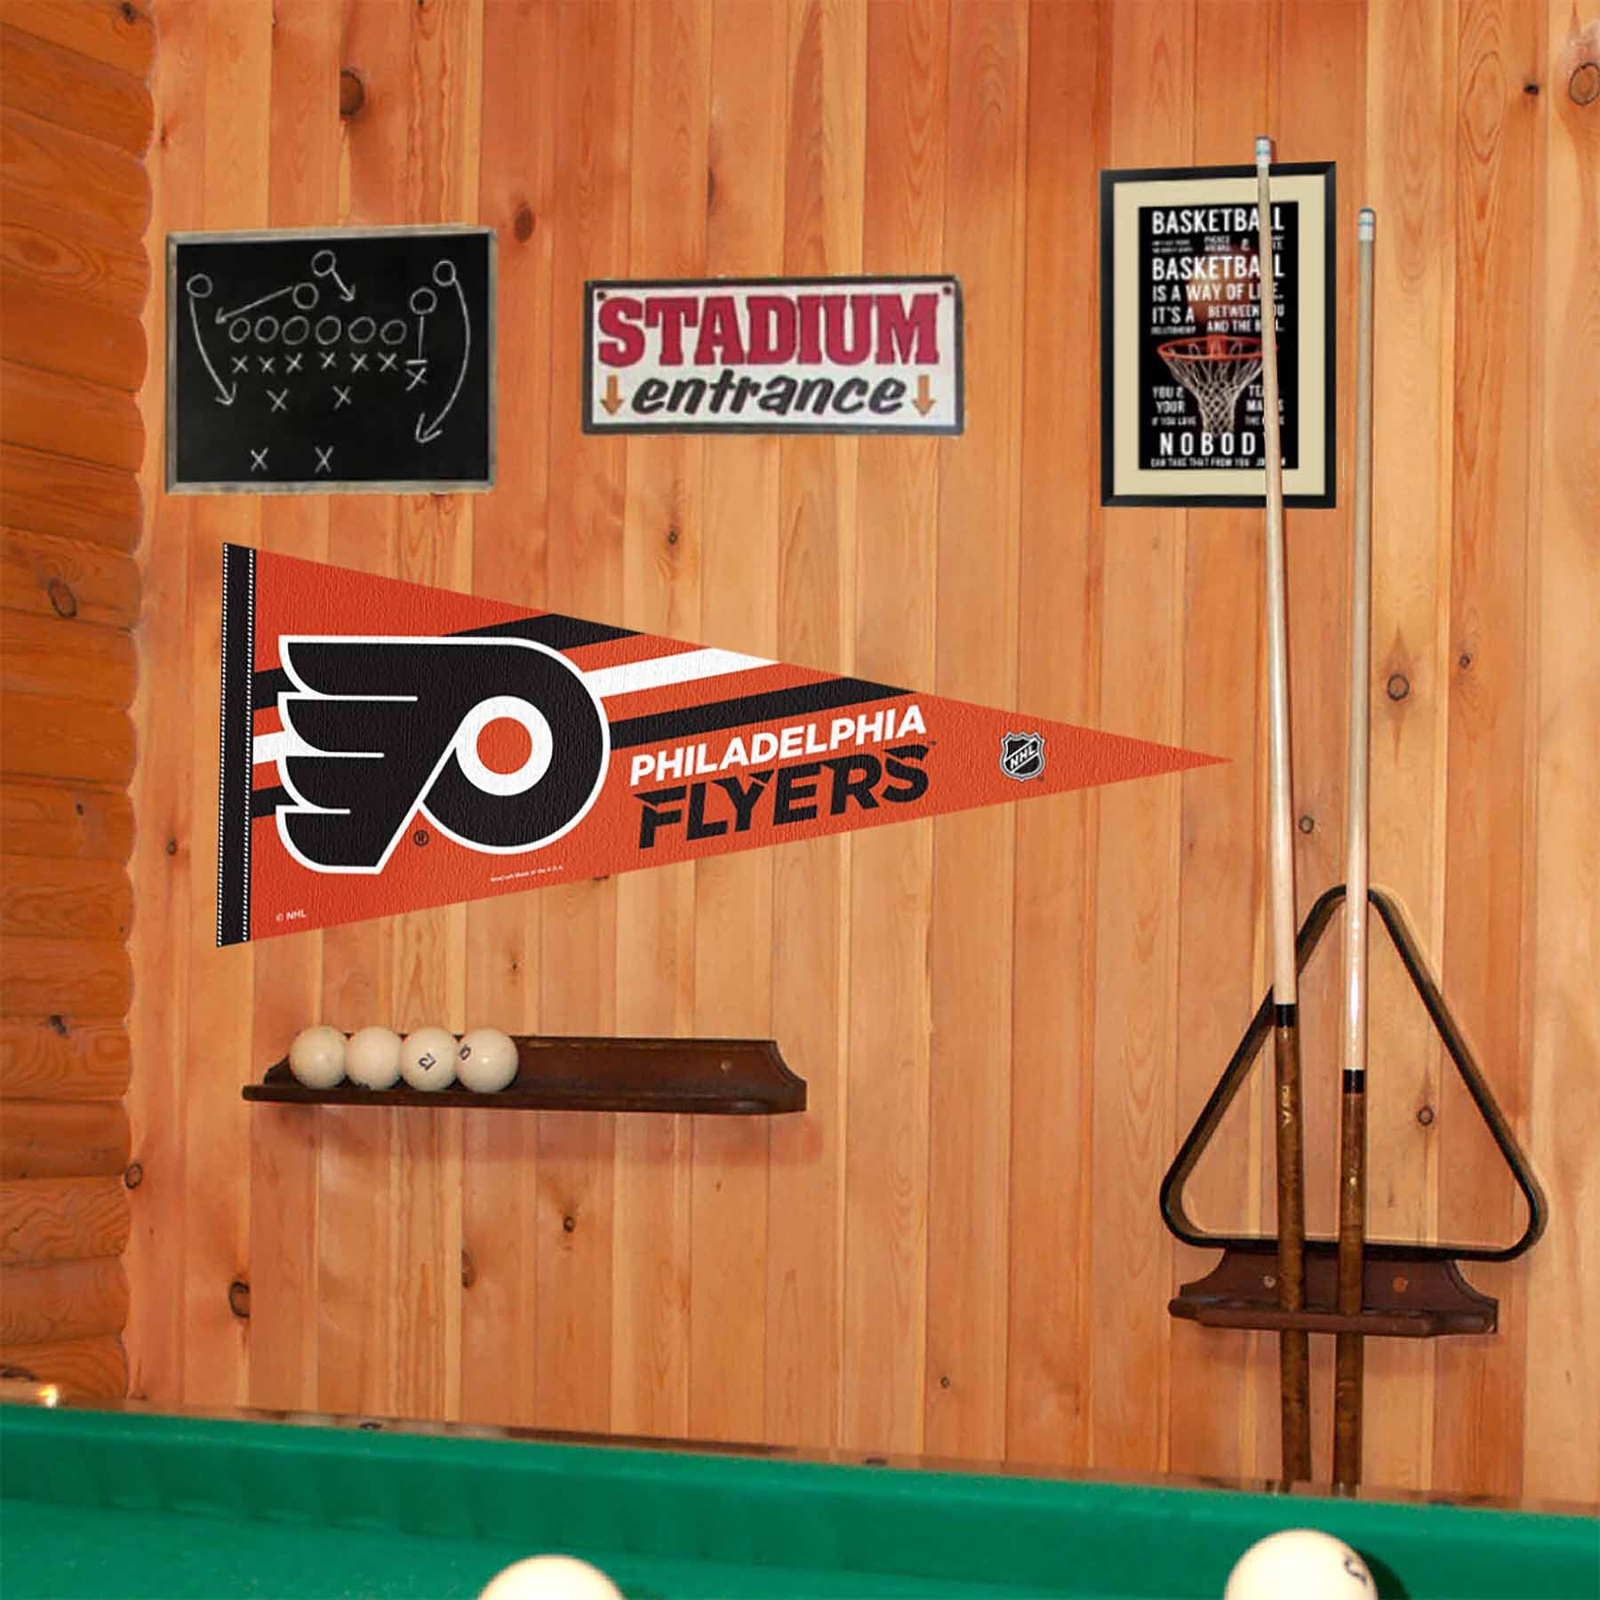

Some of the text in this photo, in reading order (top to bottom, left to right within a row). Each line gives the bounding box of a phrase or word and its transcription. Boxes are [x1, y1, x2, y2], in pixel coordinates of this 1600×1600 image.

[1152, 206, 1285, 235] BASKETBAL
[1152, 253, 1285, 281] BASKETBAL
[1152, 285, 1167, 303] IS
[1170, 284, 1182, 302] A
[1185, 283, 1222, 302] WAY
[1226, 283, 1244, 300] OF
[1152, 306, 1181, 324] IT'S
[1185, 306, 1195, 324] A
[598, 293, 940, 367] STADIUM
[631, 369, 907, 416] entrance
[1160, 432, 1256, 456] NOBOD
[630, 705, 927, 786] PHILADELPHIA
[1010, 745, 1036, 769] NHL
[633, 744, 930, 849] FLYERS
